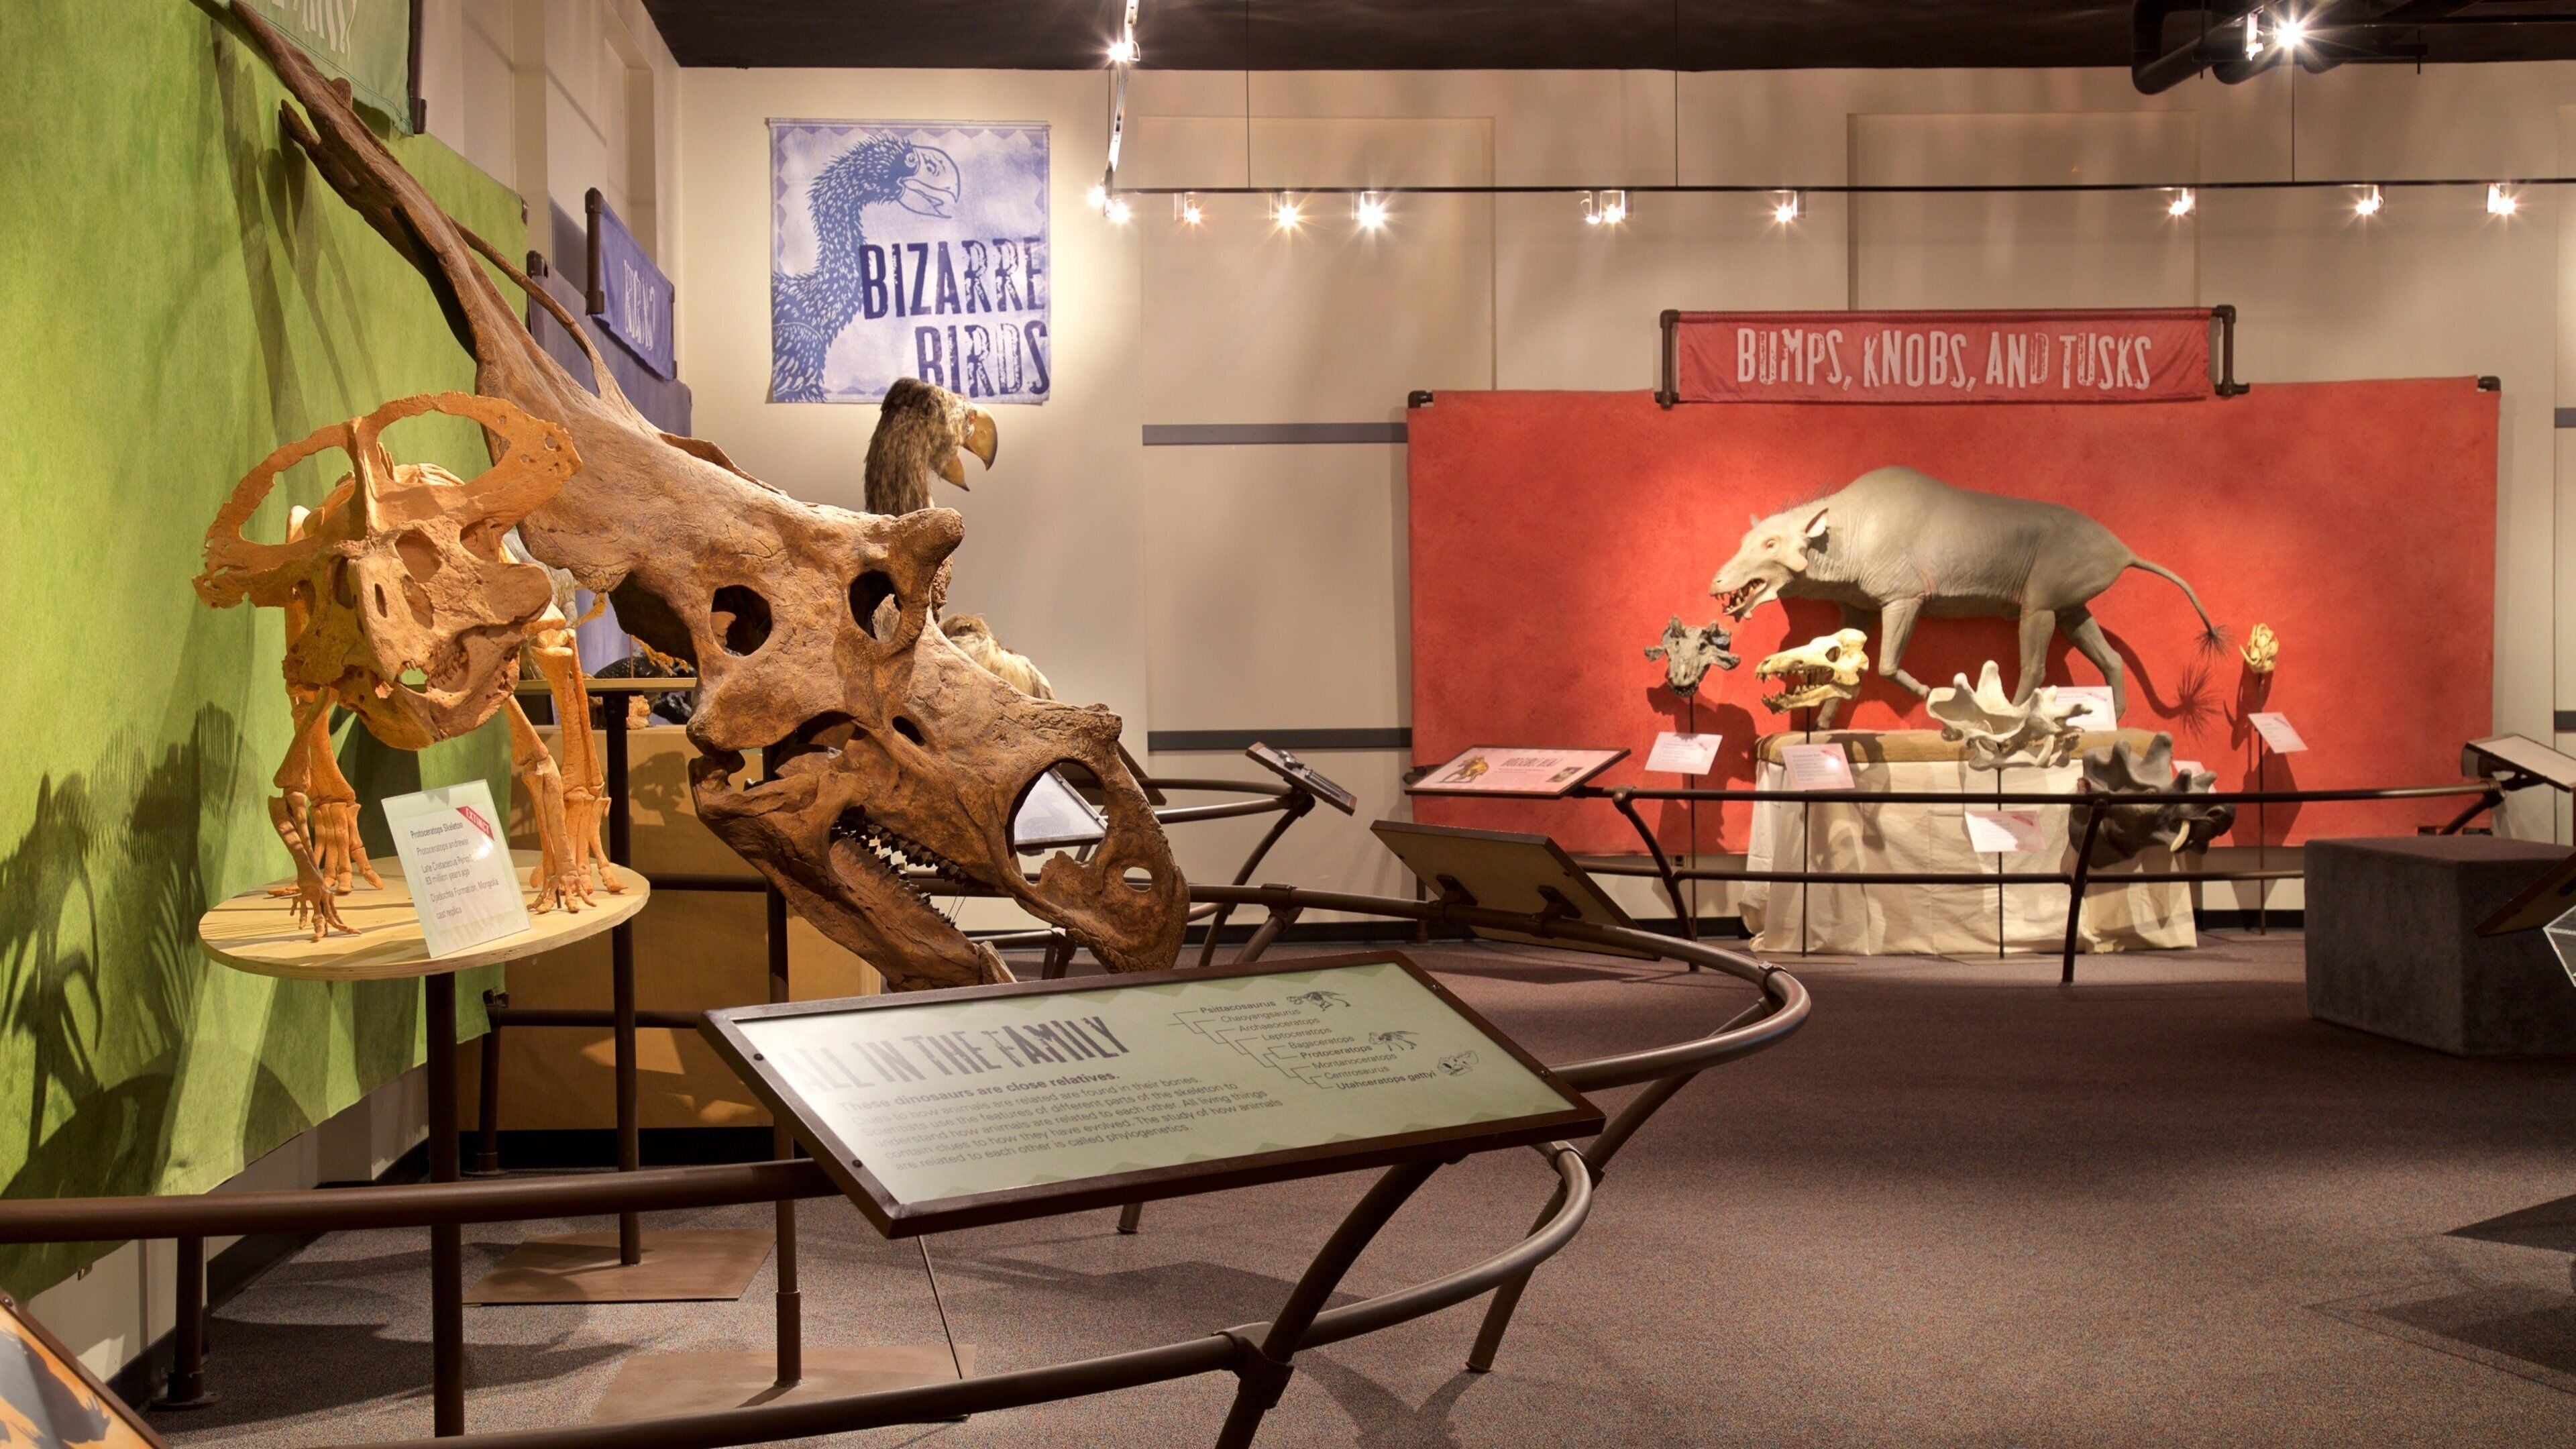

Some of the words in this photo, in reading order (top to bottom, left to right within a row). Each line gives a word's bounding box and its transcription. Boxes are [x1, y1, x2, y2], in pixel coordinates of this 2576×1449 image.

[859, 236, 1045, 320] BIZARRE
[914, 320, 1050, 398] BIRDS
[1736, 327, 1853, 391] BUMPS,
[1863, 329, 1975, 392] KNOBS,
[1986, 331, 2049, 388] AND
[2059, 331, 2152, 390] TUSKS
[466, 806, 490, 835] EXTINCT
[410, 826, 443, 839] Protoceratops
[443, 822, 464, 832] Skeleton
[416, 844, 449, 855] Protoceratops
[421, 864, 433, 873] Late
[432, 859, 458, 871] Cretaceous
[432, 873, 448, 883] million
[449, 871, 462, 881] years
[462, 869, 470, 877] ago
[478, 877, 499, 890] Mongolia
[436, 910, 446, 919] cast
[446, 906, 462, 918] replica
[1199, 1000, 1277, 1014] Psittacosaurus
[1220, 1008, 1301, 1022] Chaoyangsaurus
[1239, 1018, 1320, 1032] Archaeoceratops
[1261, 1027, 1332, 1041] Leptoceratops
[1288, 1035, 1355, 1049] Bagaceratops
[852, 1039, 926, 1083] IN
[901, 1030, 1002, 1076] THE
[981, 1016, 1130, 1068] FAMILY
[1300, 1044, 1373, 1059] Protoceratops
[1312, 1053, 1397, 1069] Montanoceratops
[1324, 1065, 1390, 1079] Centrosaurus
[1336, 1076, 1406, 1090] Utahceratops
[1407, 1070, 1436, 1082] gettyi
[836, 1097, 891, 1112] These
[894, 1089, 975, 1105] dinosaurs
[977, 1083, 1003, 1095] are
[1006, 1080, 1047, 1092] close
[1049, 1072, 1120, 1087] relatives.
[893, 1111, 908, 1121] to
[910, 1108, 938, 1118] how
[941, 1101, 991, 1114] animals
[992, 1099, 1014, 1108] are
[1015, 1093, 1059, 1106] related
[1060, 1091, 1080, 1100] are
[1081, 1085, 1118, 1097] found
[1120, 1083, 1130, 1092] in
[1132, 1081, 1160, 1091] their
[1161, 1075, 1201, 1087] bones.
[861, 1122, 928, 1137] Scientists
[930, 1119, 955, 1128] use
[957, 1115, 978, 1125] the
[980, 1108, 1034, 1122] features
[1036, 1105, 1048, 1115] of
[1051, 1099, 1106, 1113] different
[1104, 1095, 1136, 1107] parts
[1138, 1093, 1149, 1102] of
[1151, 1090, 1173, 1099] the
[1174, 1085, 1225, 1097] skeleton
[873, 1132, 949, 1148] understand
[949, 1128, 978, 1137] how
[981, 1120, 1031, 1134] animals
[1032, 1118, 1053, 1127] are
[1055, 1112, 1098, 1124] related
[1099, 1109, 1114, 1118] to
[1115, 1106, 1144, 1116] each
[1146, 1102, 1181, 1113] other.
[1182, 1098, 1197, 1107] All
[1199, 1093, 1232, 1106] living
[1231, 1089, 1268, 1102] things
[884, 1144, 933, 1159] contain
[936, 1140, 971, 1152] clues
[972, 1138, 987, 1147] to
[987, 1134, 1018, 1144] how
[1019, 1131, 1048, 1144] they
[1049, 1126, 1081, 1137] have
[1083, 1119, 1136, 1132] evolved.
[1135, 1116, 1160, 1125] The
[1161, 1111, 1194, 1122] study
[1196, 1108, 1209, 1117] of
[1210, 1106, 1237, 1116] how
[1238, 1099, 1283, 1112] animals
[895, 1161, 918, 1171] are
[920, 1155, 966, 1168] related
[967, 1151, 983, 1161] to
[985, 1147, 1017, 1159] each
[1018, 1142, 1052, 1154] other
[1053, 1140, 1066, 1148] is
[1068, 1134, 1104, 1146] called
[1104, 1123, 1193, 1142] phylogenetics.
